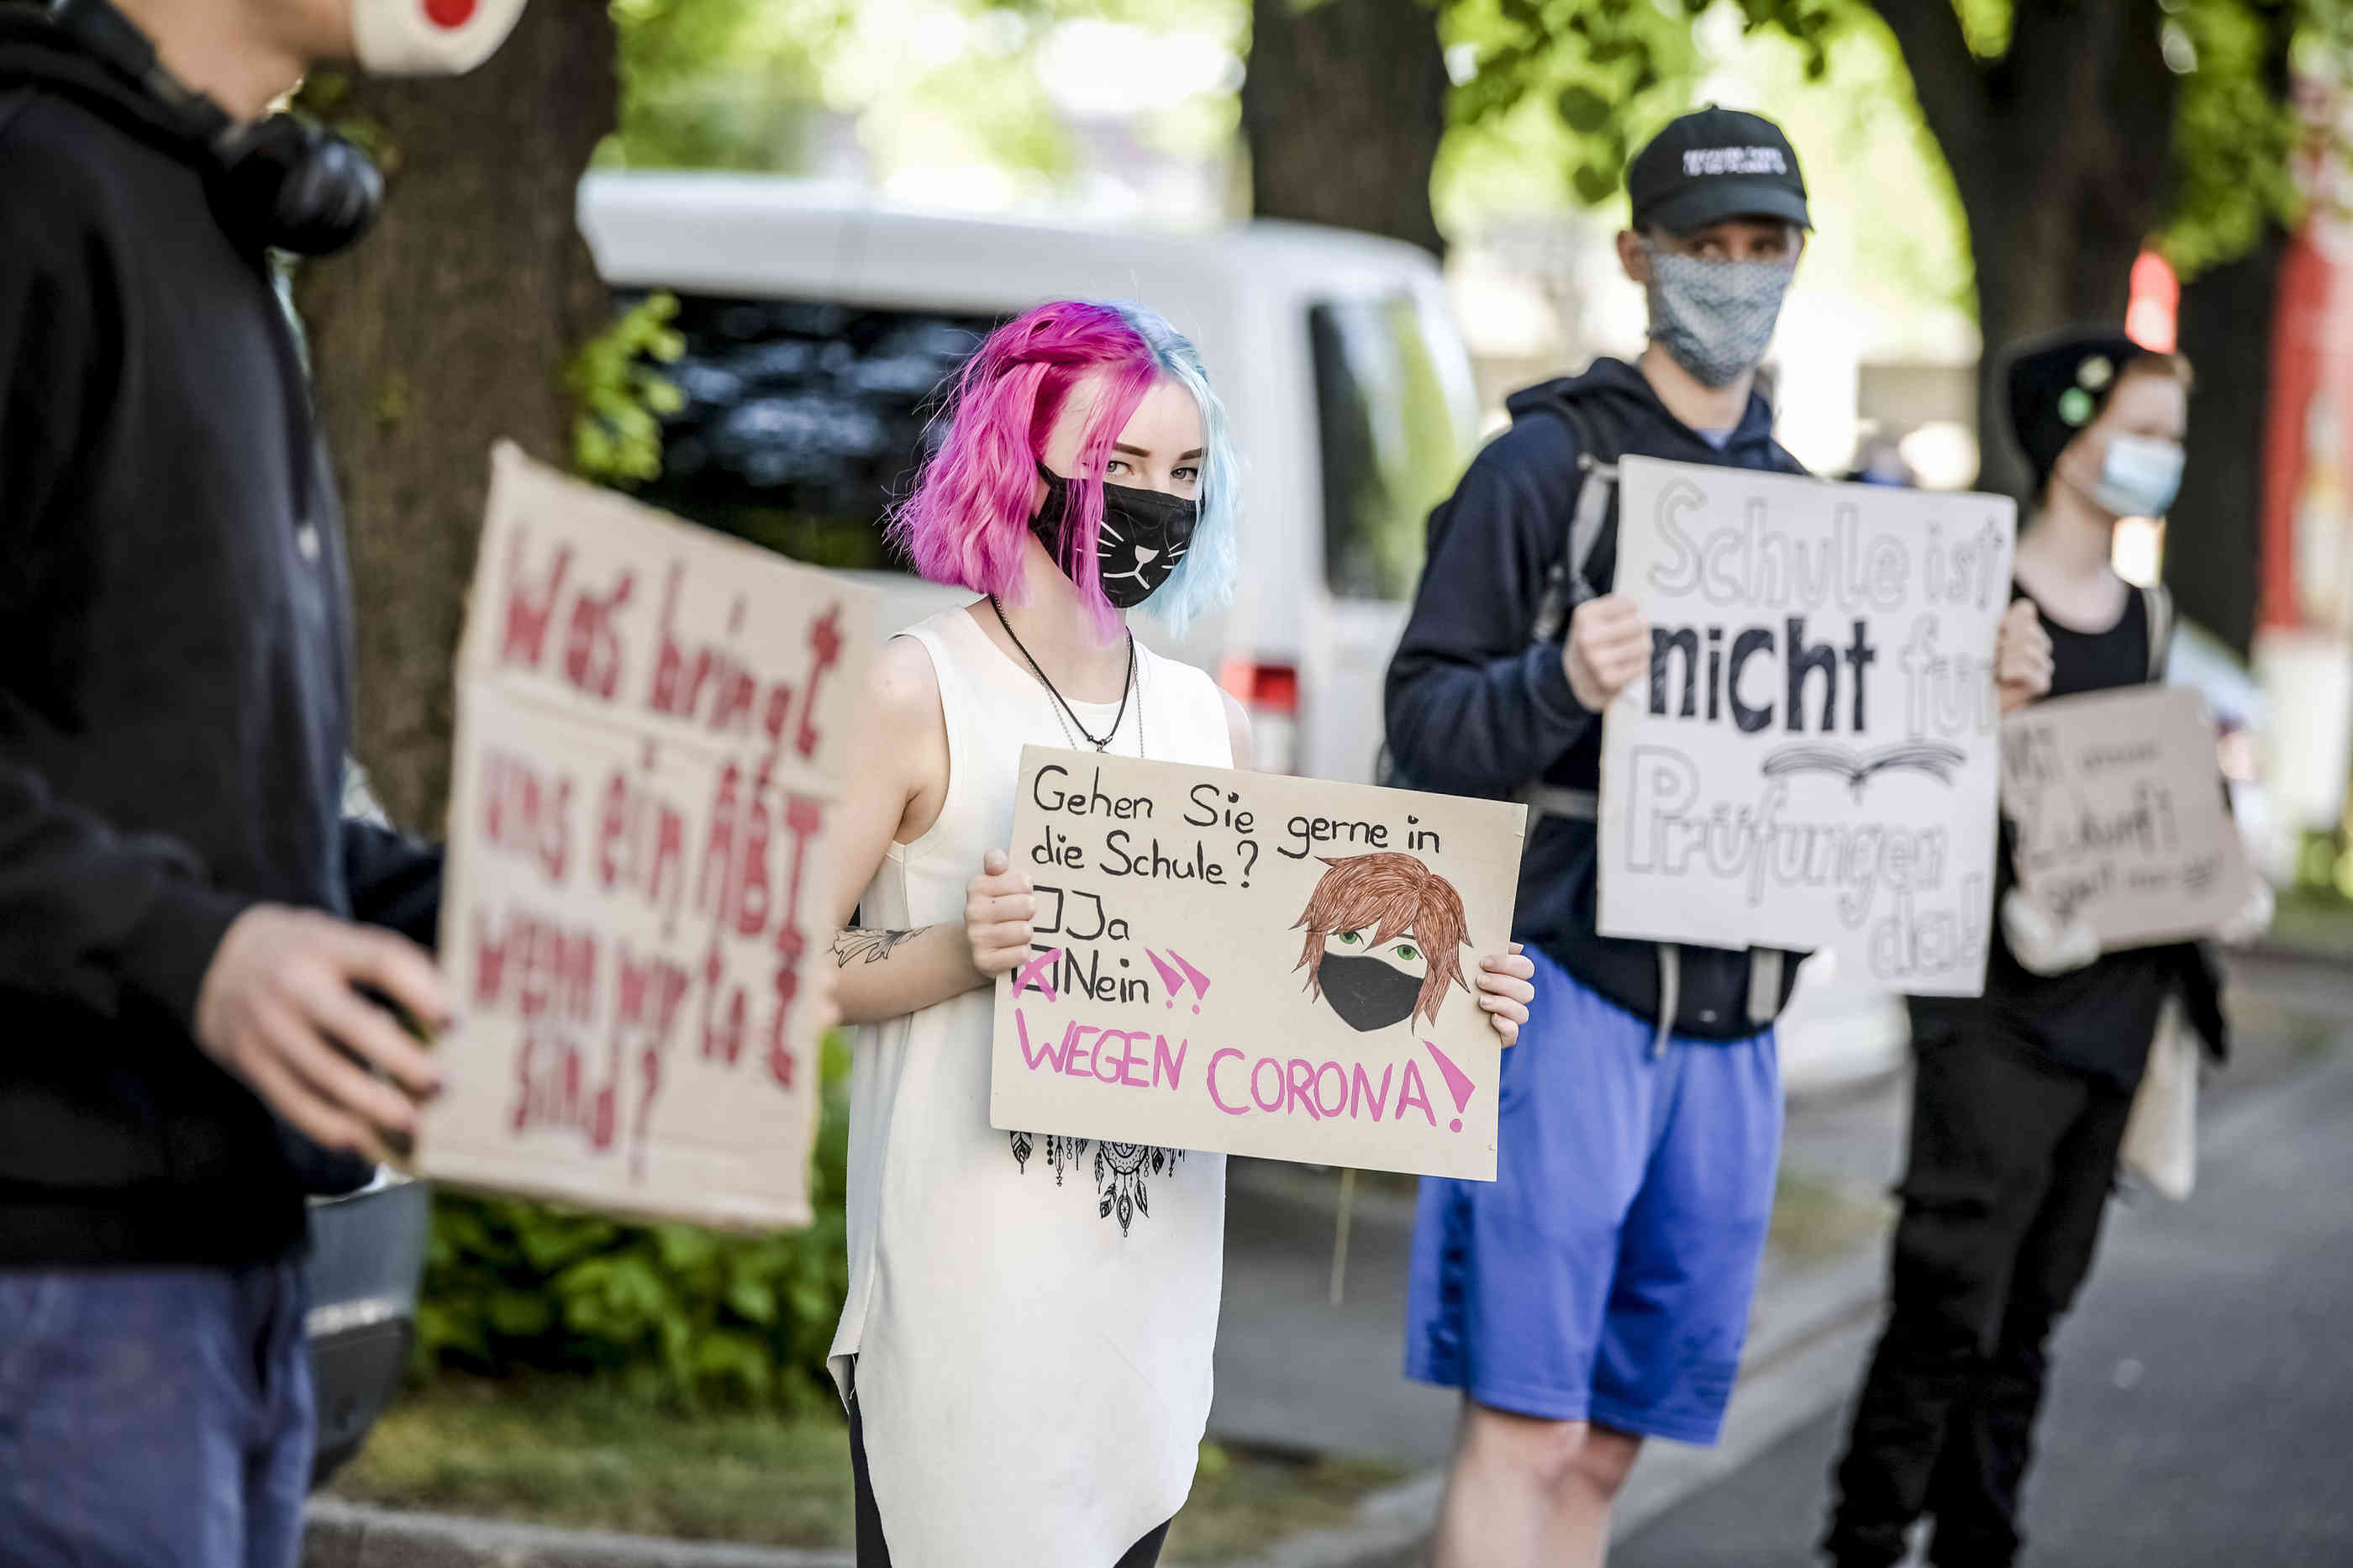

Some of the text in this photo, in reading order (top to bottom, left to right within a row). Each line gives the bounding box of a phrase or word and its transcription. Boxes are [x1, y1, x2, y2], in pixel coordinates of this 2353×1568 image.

[1648, 476, 2004, 613] Schule ist
[500, 523, 636, 700] Was
[1647, 614, 1875, 734] nicht
[1031, 825, 1085, 869] die
[1034, 765, 1440, 859] Gehen Sie gerne in
[1625, 745, 1948, 927] Prüfungen
[1065, 891, 1129, 940] Ja
[1015, 1008, 1477, 1133] WEGEN CORONA!
